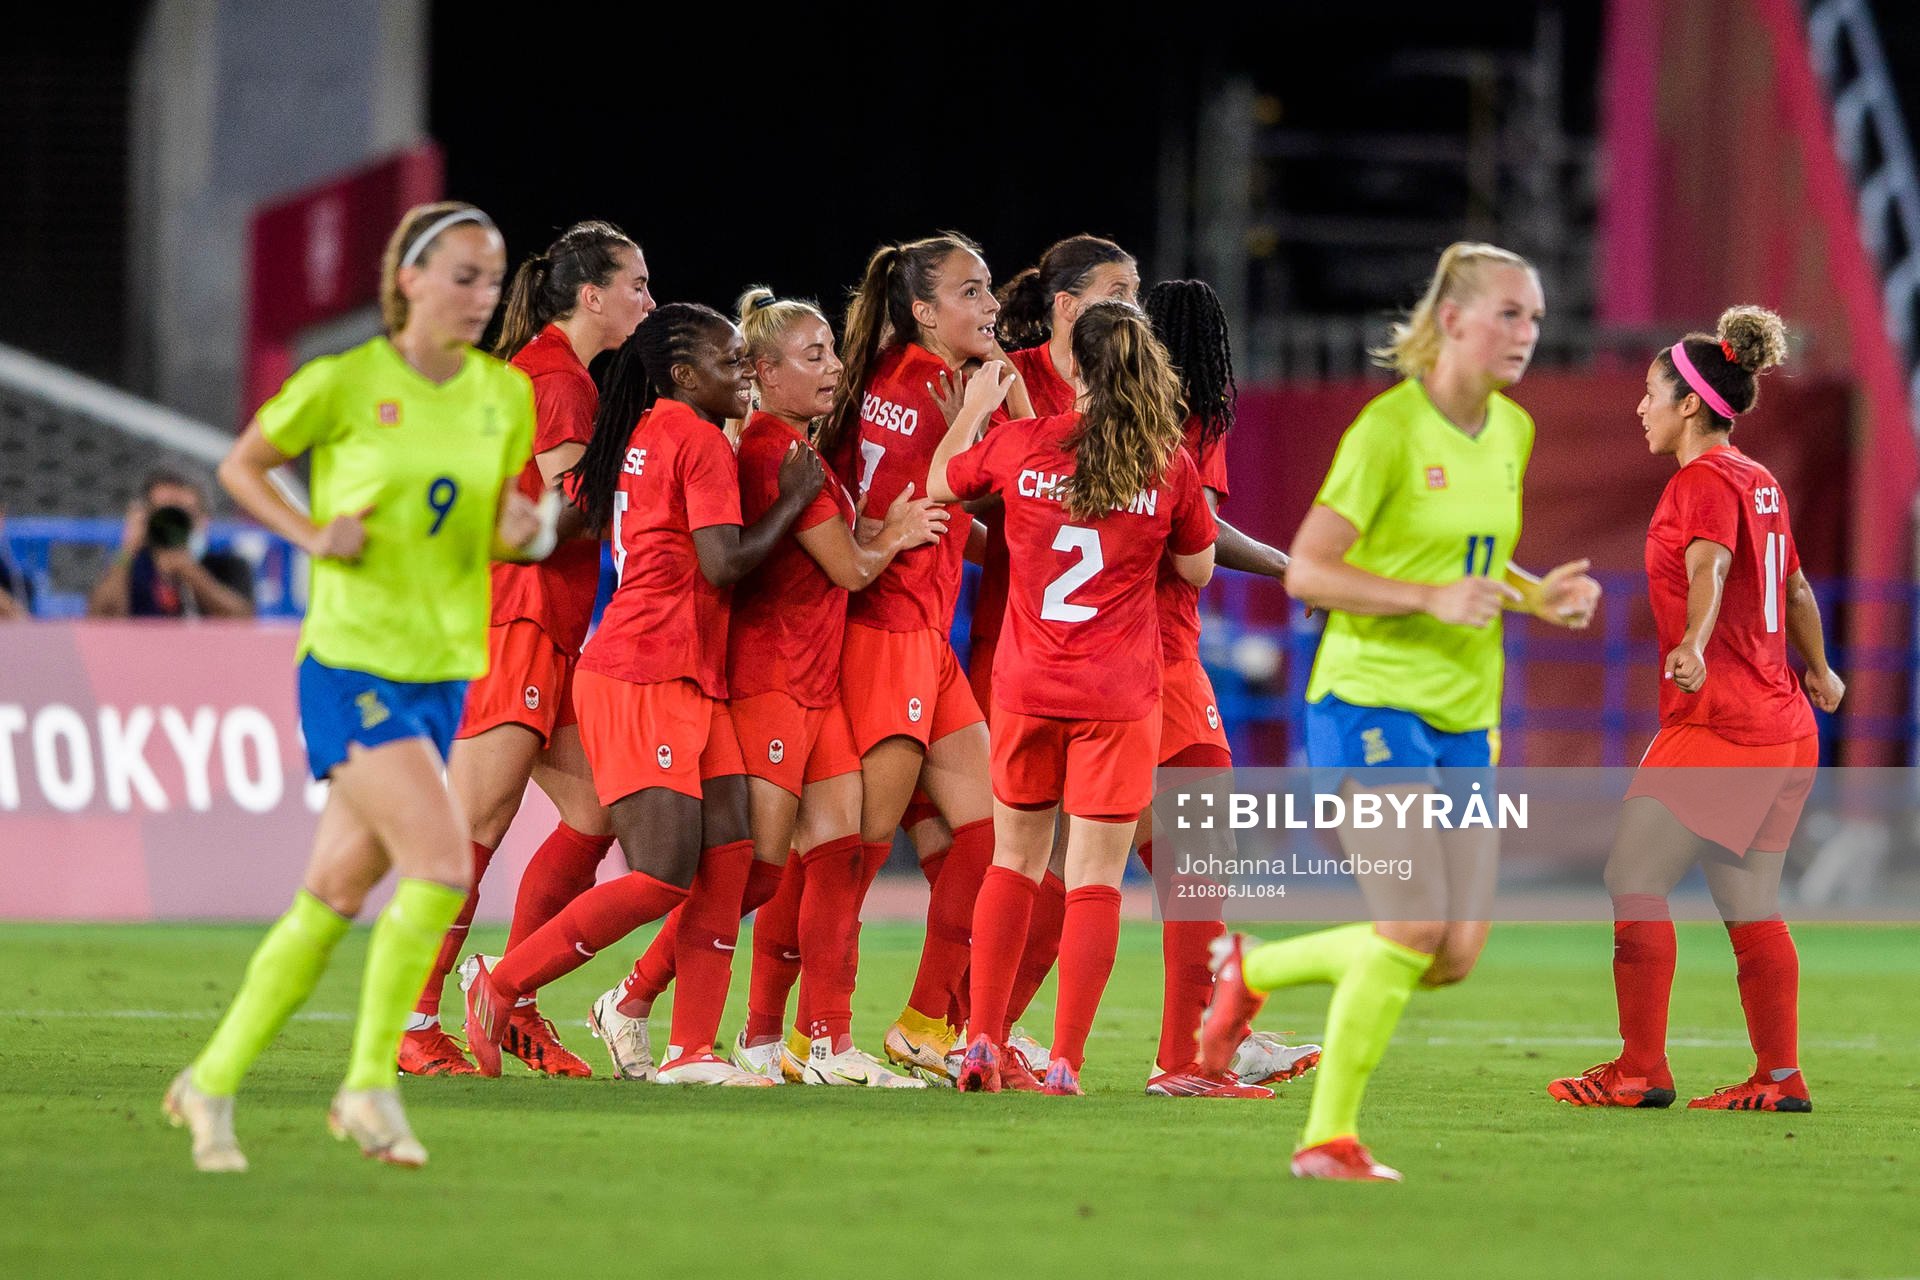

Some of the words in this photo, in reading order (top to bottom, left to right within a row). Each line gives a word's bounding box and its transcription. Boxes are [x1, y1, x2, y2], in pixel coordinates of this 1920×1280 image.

[427, 477, 457, 536] 9
[1040, 525, 1104, 622] 2
[0, 703, 284, 813] TOKYO
